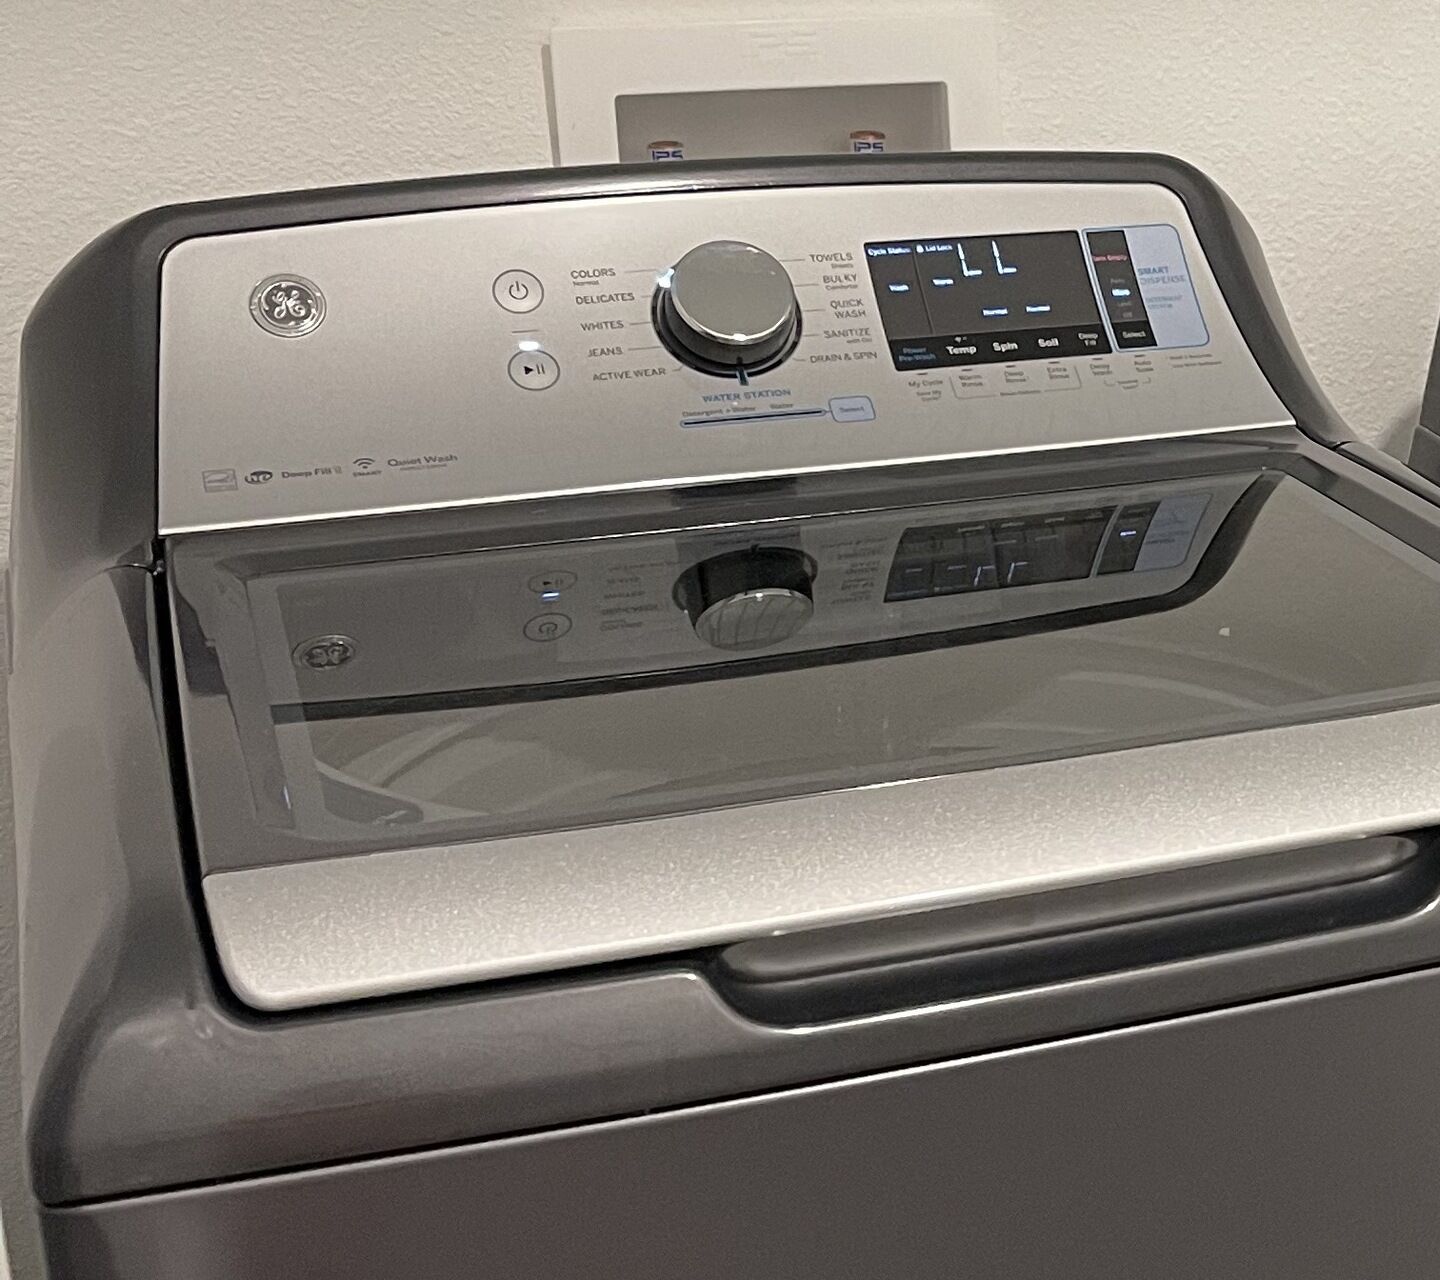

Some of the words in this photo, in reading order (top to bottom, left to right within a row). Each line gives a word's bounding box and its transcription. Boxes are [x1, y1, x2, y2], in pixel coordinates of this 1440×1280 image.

[809, 252, 853, 262] TOWELS
[570, 268, 616, 279] COLORS
[822, 273, 857, 283] BULKY
[575, 292, 635, 305] DELICATES
[830, 298, 864, 309] QUICK
[835, 309, 867, 319] WASH
[580, 320, 624, 331] WHITES
[823, 327, 871, 338] SANITIZE
[993, 341, 1018, 353] Spin
[1038, 338, 1060, 348] Soil
[587, 346, 623, 357] JEANS
[946, 344, 977, 355] Temp
[809, 353, 842, 363] DRAIN
[854, 351, 878, 360] SPIN
[592, 371, 633, 381] ACTIVE
[633, 367, 667, 378] WEAR
[702, 392, 741, 403] WATER
[744, 389, 792, 400] STATION
